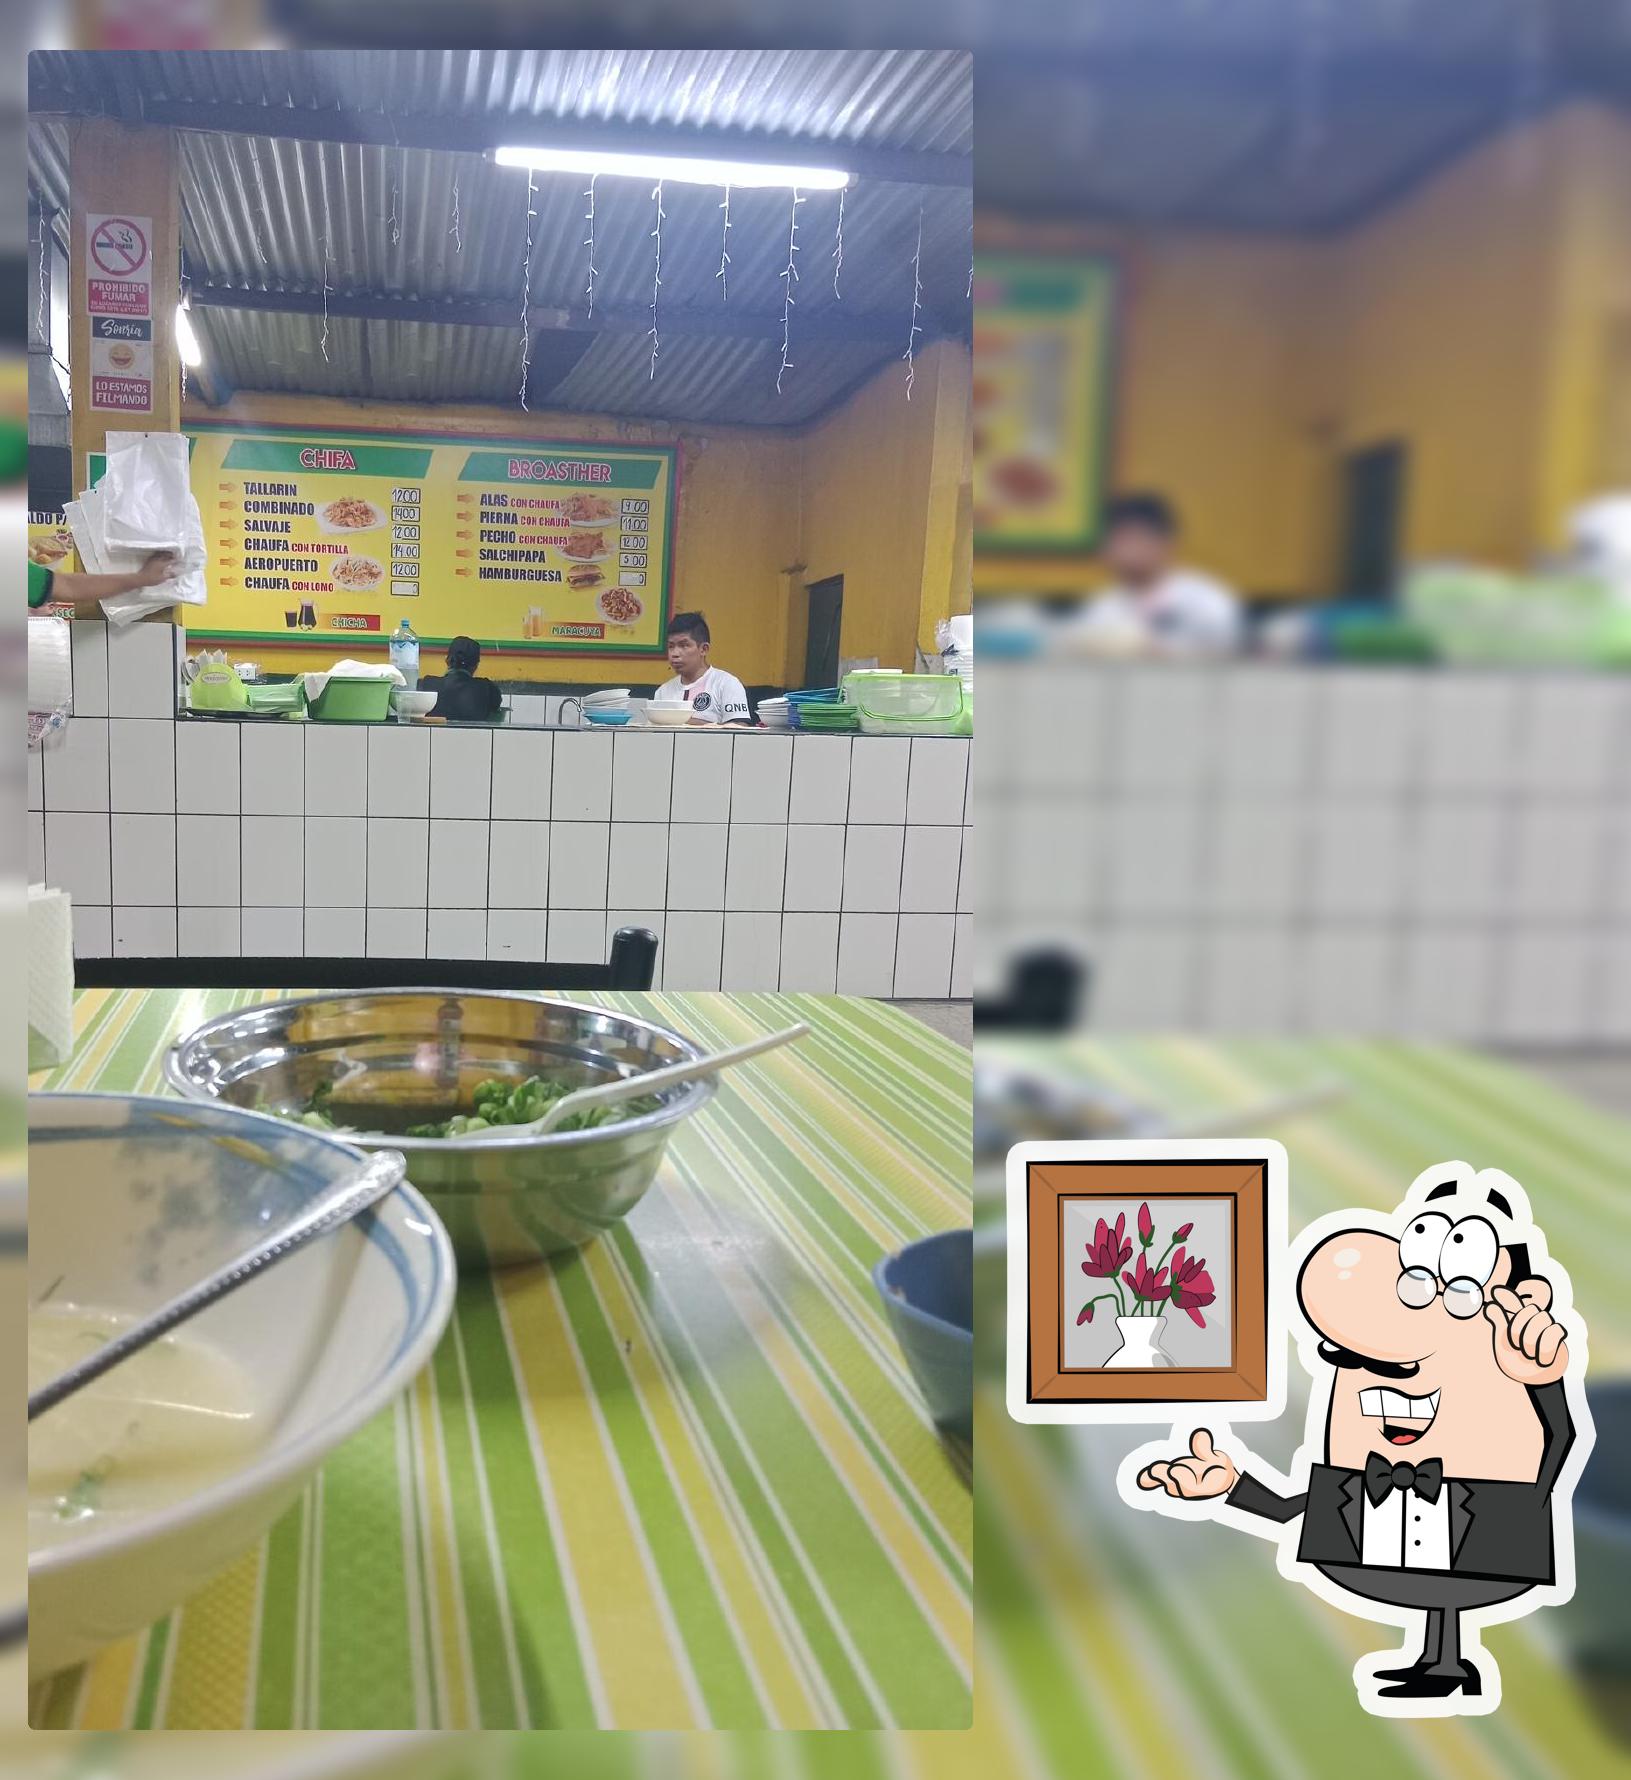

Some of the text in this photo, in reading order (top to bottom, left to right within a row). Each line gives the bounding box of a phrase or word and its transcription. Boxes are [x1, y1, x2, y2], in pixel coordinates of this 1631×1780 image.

[92, 281, 145, 294] PROHIBIDO
[101, 291, 136, 303] FUMAR
[96, 381, 148, 394] LO ESTAMOS
[96, 392, 148, 406] FILMANDO
[300, 448, 356, 470] CHIFA
[508, 459, 612, 482] BROASTHER
[243, 482, 297, 497] TALLARIN
[243, 500, 315, 517] COMBINADO
[480, 493, 560, 510] ALAS CON CHAUFA
[244, 519, 291, 534] SALVAJE
[480, 511, 570, 528] PIERNA CON CHAUFA
[480, 529, 568, 546] PECHO CON CHAUFA
[244, 538, 349, 555] CHAUFA CON TORTILLA
[479, 549, 546, 564] SALCHIPAPA
[244, 557, 319, 573] AEROPUERTO
[479, 567, 562, 583] HAMBURGUESA
[244, 576, 334, 593] CHAUFA CON LOMO
[331, 615, 368, 629] CHICHA
[724, 703, 748, 713] QNB
